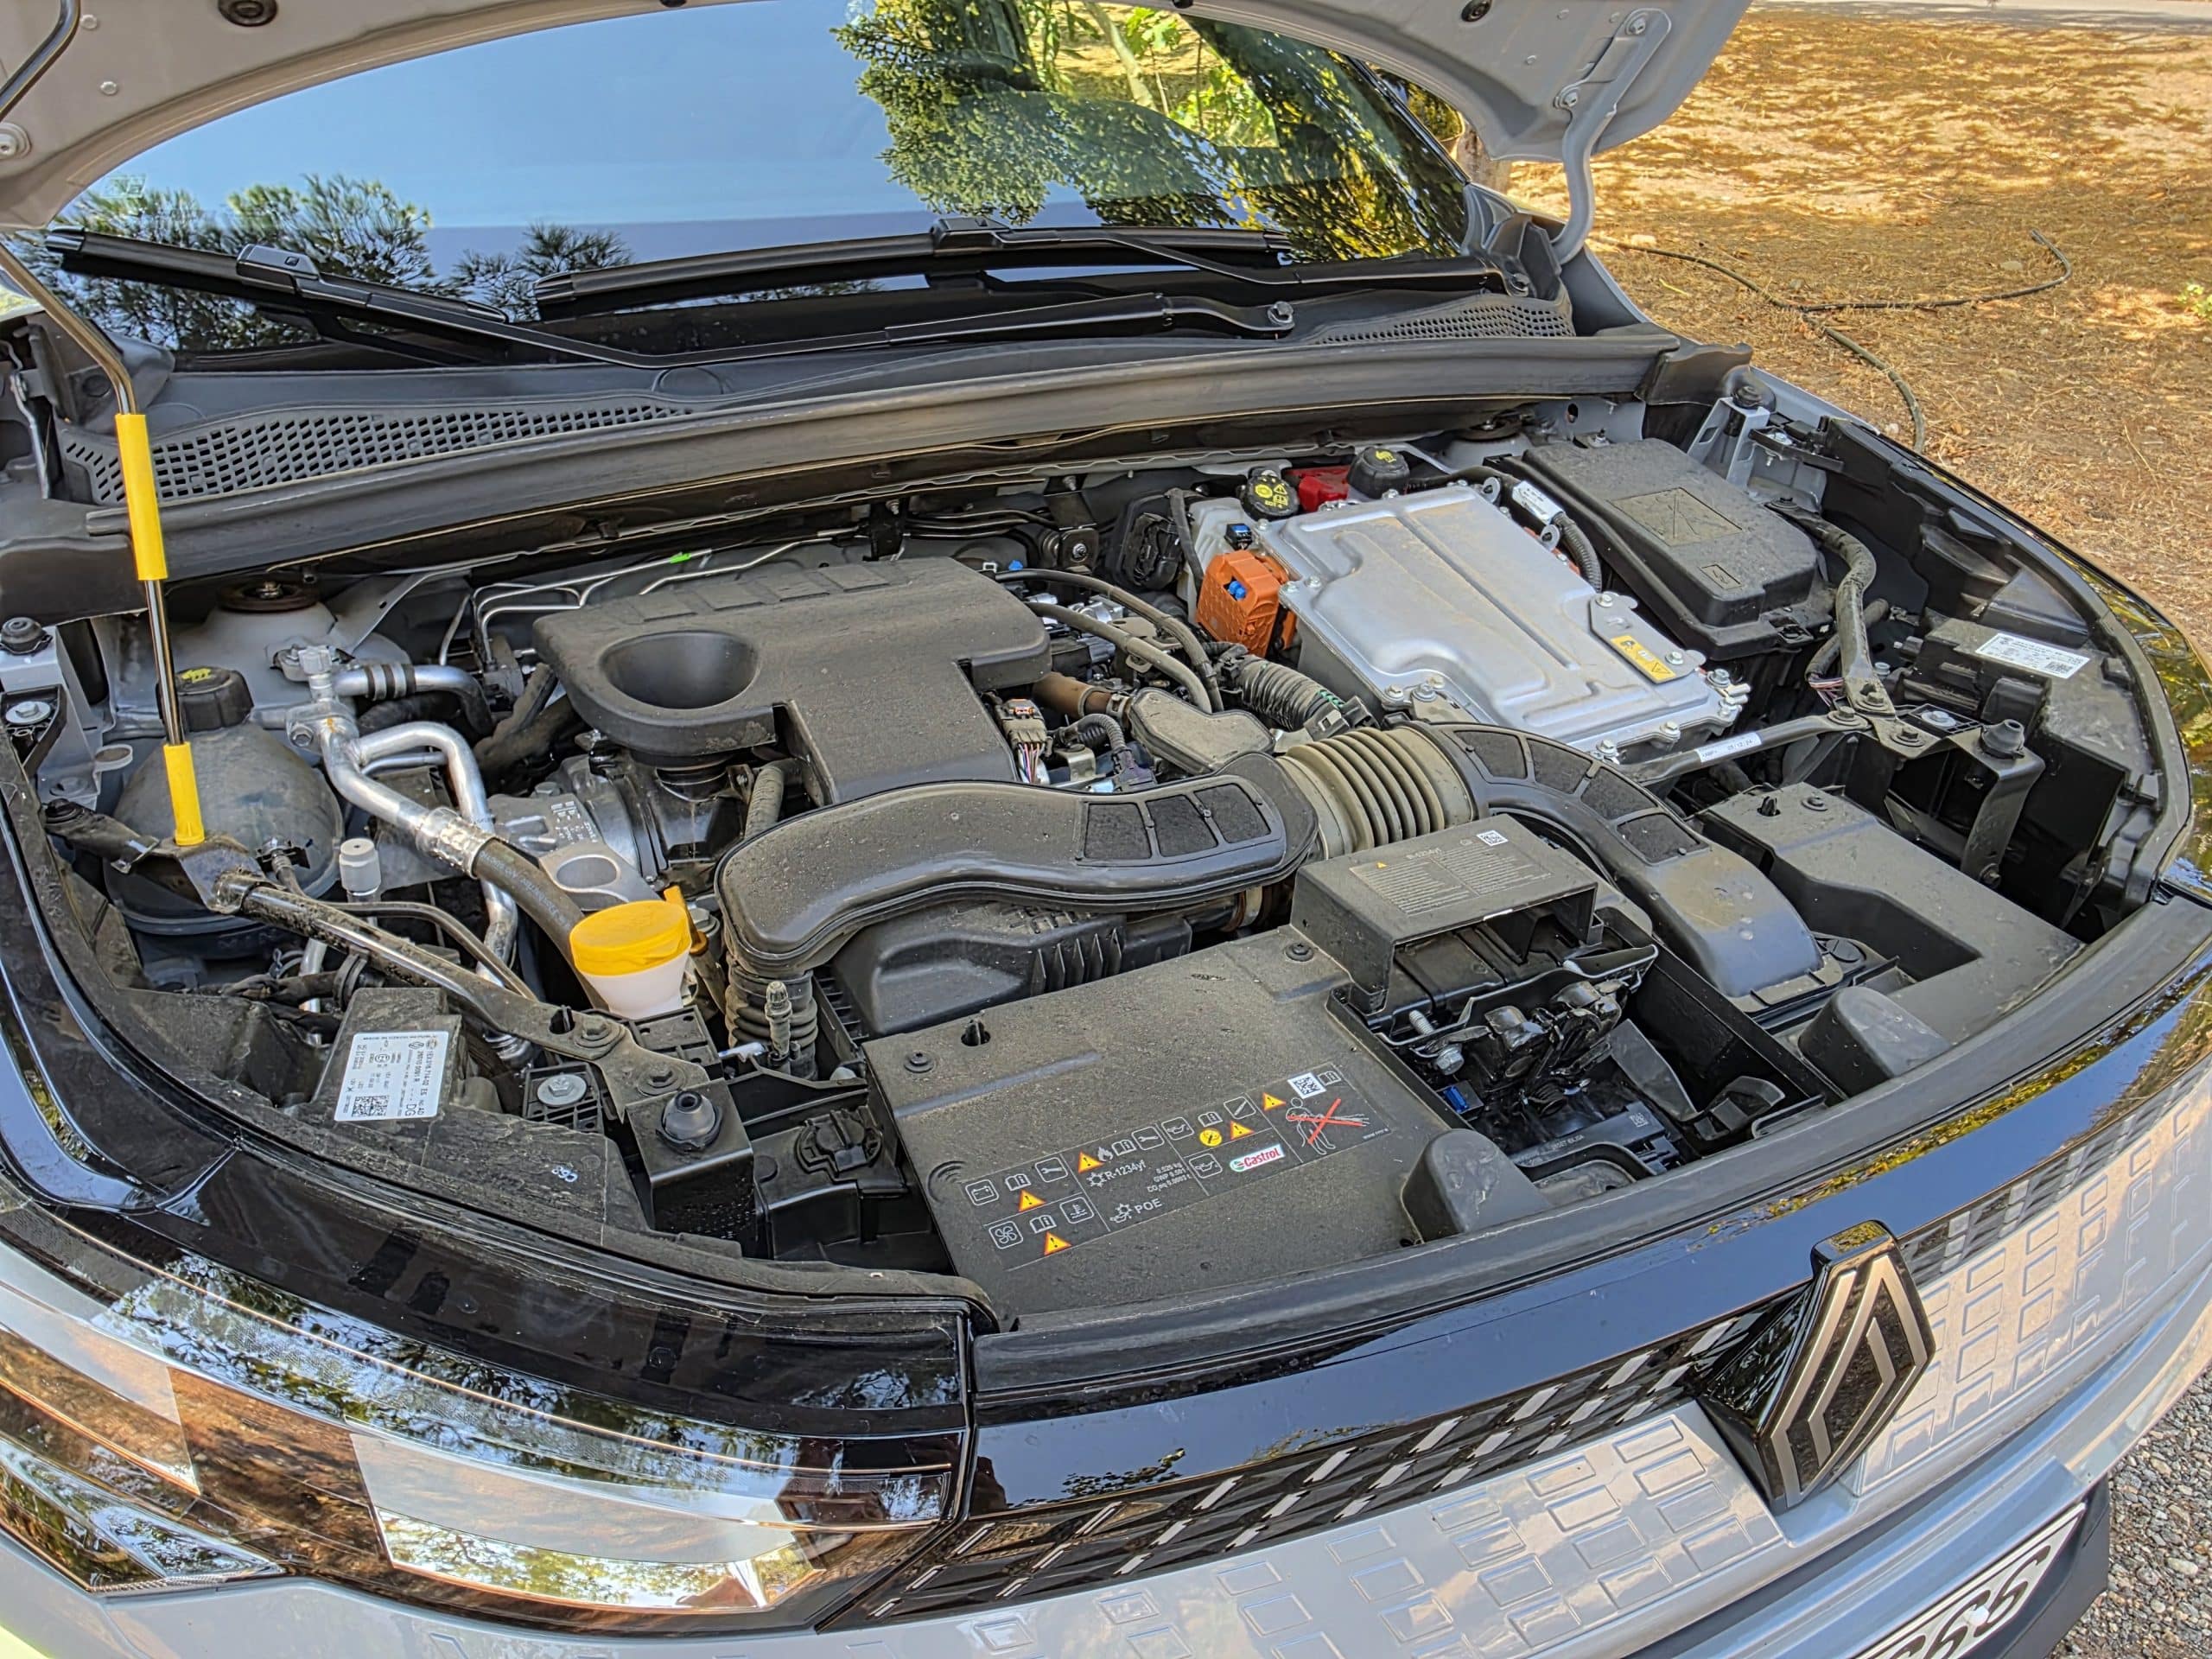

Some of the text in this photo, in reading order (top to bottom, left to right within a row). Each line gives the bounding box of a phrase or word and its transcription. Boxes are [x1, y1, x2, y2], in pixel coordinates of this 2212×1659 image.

[1243, 1147, 1281, 1168] Castrol
[1104, 1159, 1147, 1180] R-1234yf
[1134, 1198, 1163, 1214] POE
